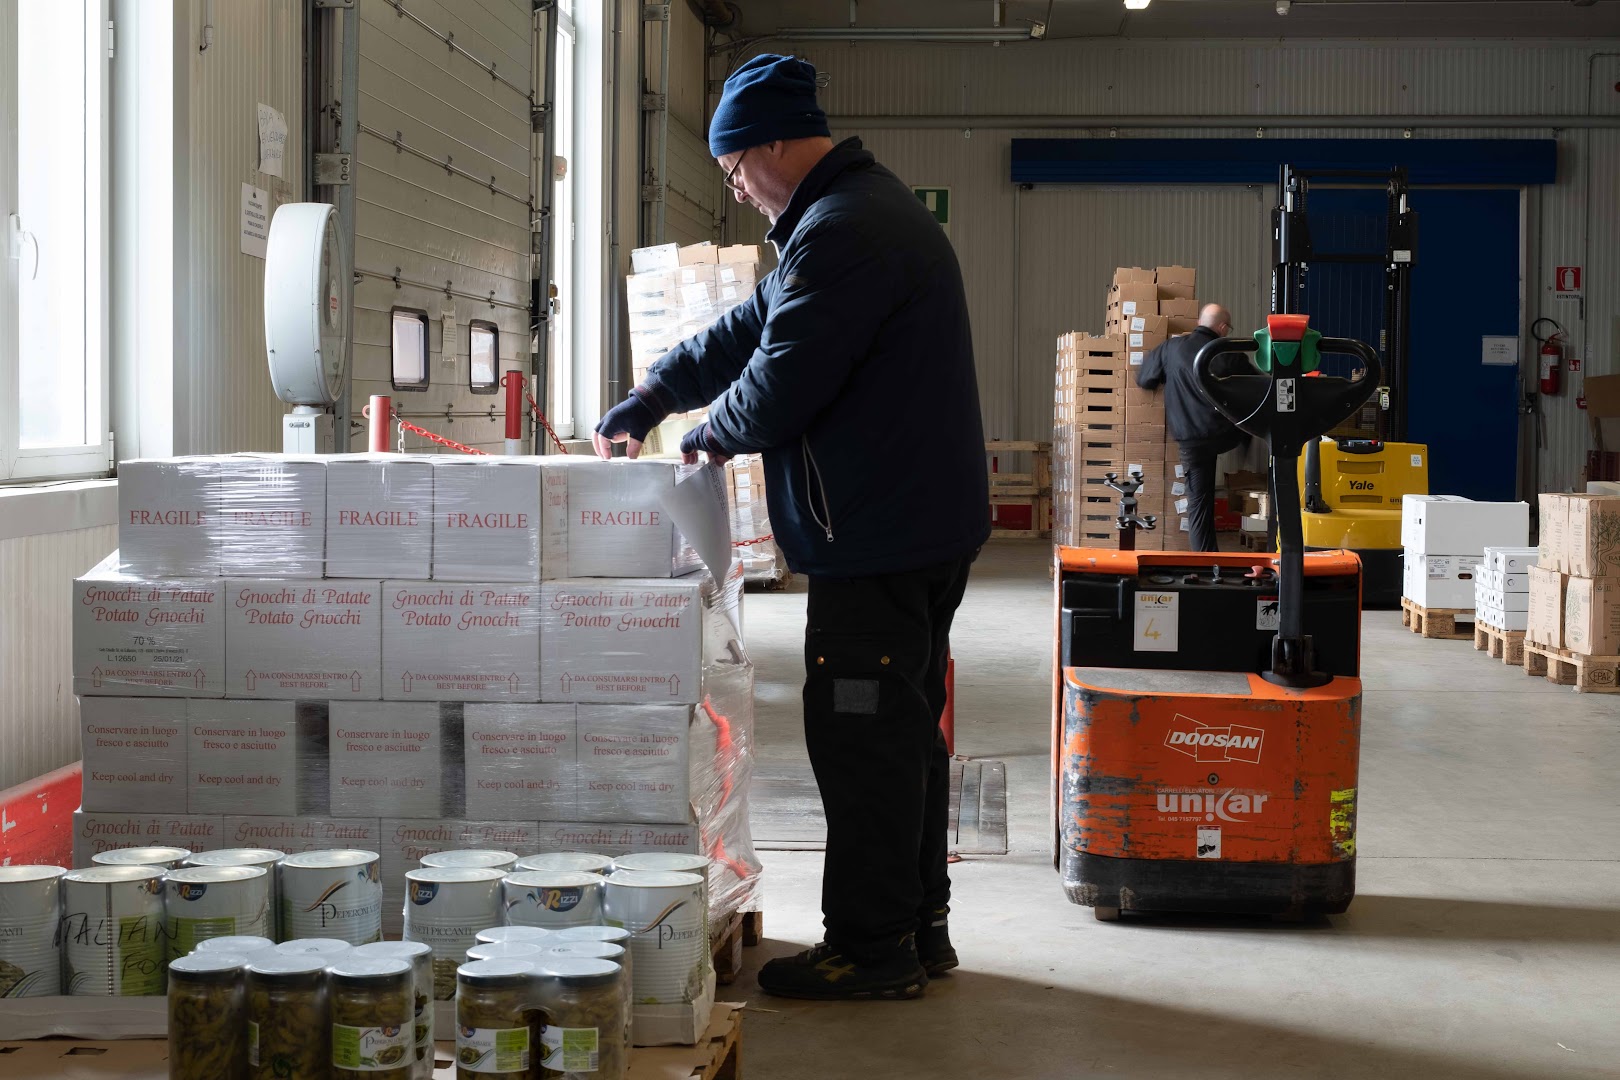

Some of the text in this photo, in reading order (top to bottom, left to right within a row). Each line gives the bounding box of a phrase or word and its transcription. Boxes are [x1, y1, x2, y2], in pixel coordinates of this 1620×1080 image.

[1349, 480, 1374, 490] Yale
[130, 510, 206, 525] FRAGILE
[234, 511, 312, 526] FRAGILE
[339, 510, 419, 526] FRAGILE
[447, 512, 528, 528] FRAGILE
[580, 510, 660, 526] FRAGILE
[82, 586, 214, 605] Gnocchi di Patate
[236, 588, 370, 608] Gnocchi di Patate
[392, 590, 530, 609] Gnocchi di Patate
[551, 590, 690, 611] Gnocchi di Patate
[92, 606, 204, 626] Potato Gnocchi
[245, 608, 361, 628] Potato Gnocchi
[402, 610, 520, 630] Potato Gnocchi
[560, 612, 680, 632] Potato Gnocchi
[133, 636, 156, 646] 70 %
[153, 655, 184, 663] 25/01/21
[116, 670, 166, 678] CONSUMARSI
[259, 672, 272, 680] DA
[273, 673, 320, 681] CONSUMARSI
[428, 674, 478, 682] CONSUMARSI
[639, 676, 666, 684] ENTRO
[280, 680, 328, 689] BEST BEFORE
[436, 682, 455, 690] BEST
[596, 684, 646, 692] BEST BEFORE
[87, 724, 178, 737] Conservare in luogo
[194, 727, 286, 739] Conservare in luogo
[336, 729, 430, 742] Conservare in luogo
[96, 738, 123, 747] fresco
[133, 739, 169, 748] asciutto
[472, 732, 566, 743] Conservare in luogo
[584, 732, 679, 745] Conservare in luogo
[1169, 732, 1260, 749] DOOSAN
[203, 740, 231, 749] fresco
[240, 741, 277, 750] asciutto
[346, 741, 421, 752] fresco e asciutto
[481, 744, 510, 754] fresco
[520, 745, 557, 754] asciutto
[593, 746, 622, 756] fresco
[632, 747, 670, 756] asciutto
[92, 772, 174, 784] Keep cool and dry
[198, 774, 282, 786] Keep cool and dry
[341, 776, 425, 789] Keep cool and dry
[477, 779, 561, 792] Keep cool and dry
[589, 781, 674, 794] Keep cool and dry
[1157, 788, 1267, 822] unicar
[82, 818, 214, 838] Gnocchi di Patate
[235, 822, 370, 842] Gnocchi di Patate
[392, 825, 452, 844] Gnocchi
[460, 826, 472, 840] di
[551, 828, 690, 848] Gnocchi di Patate
[544, 889, 578, 911] RIZZI
[52, 912, 178, 949] ITALIAN
[431, 926, 472, 936] PICCANTI
